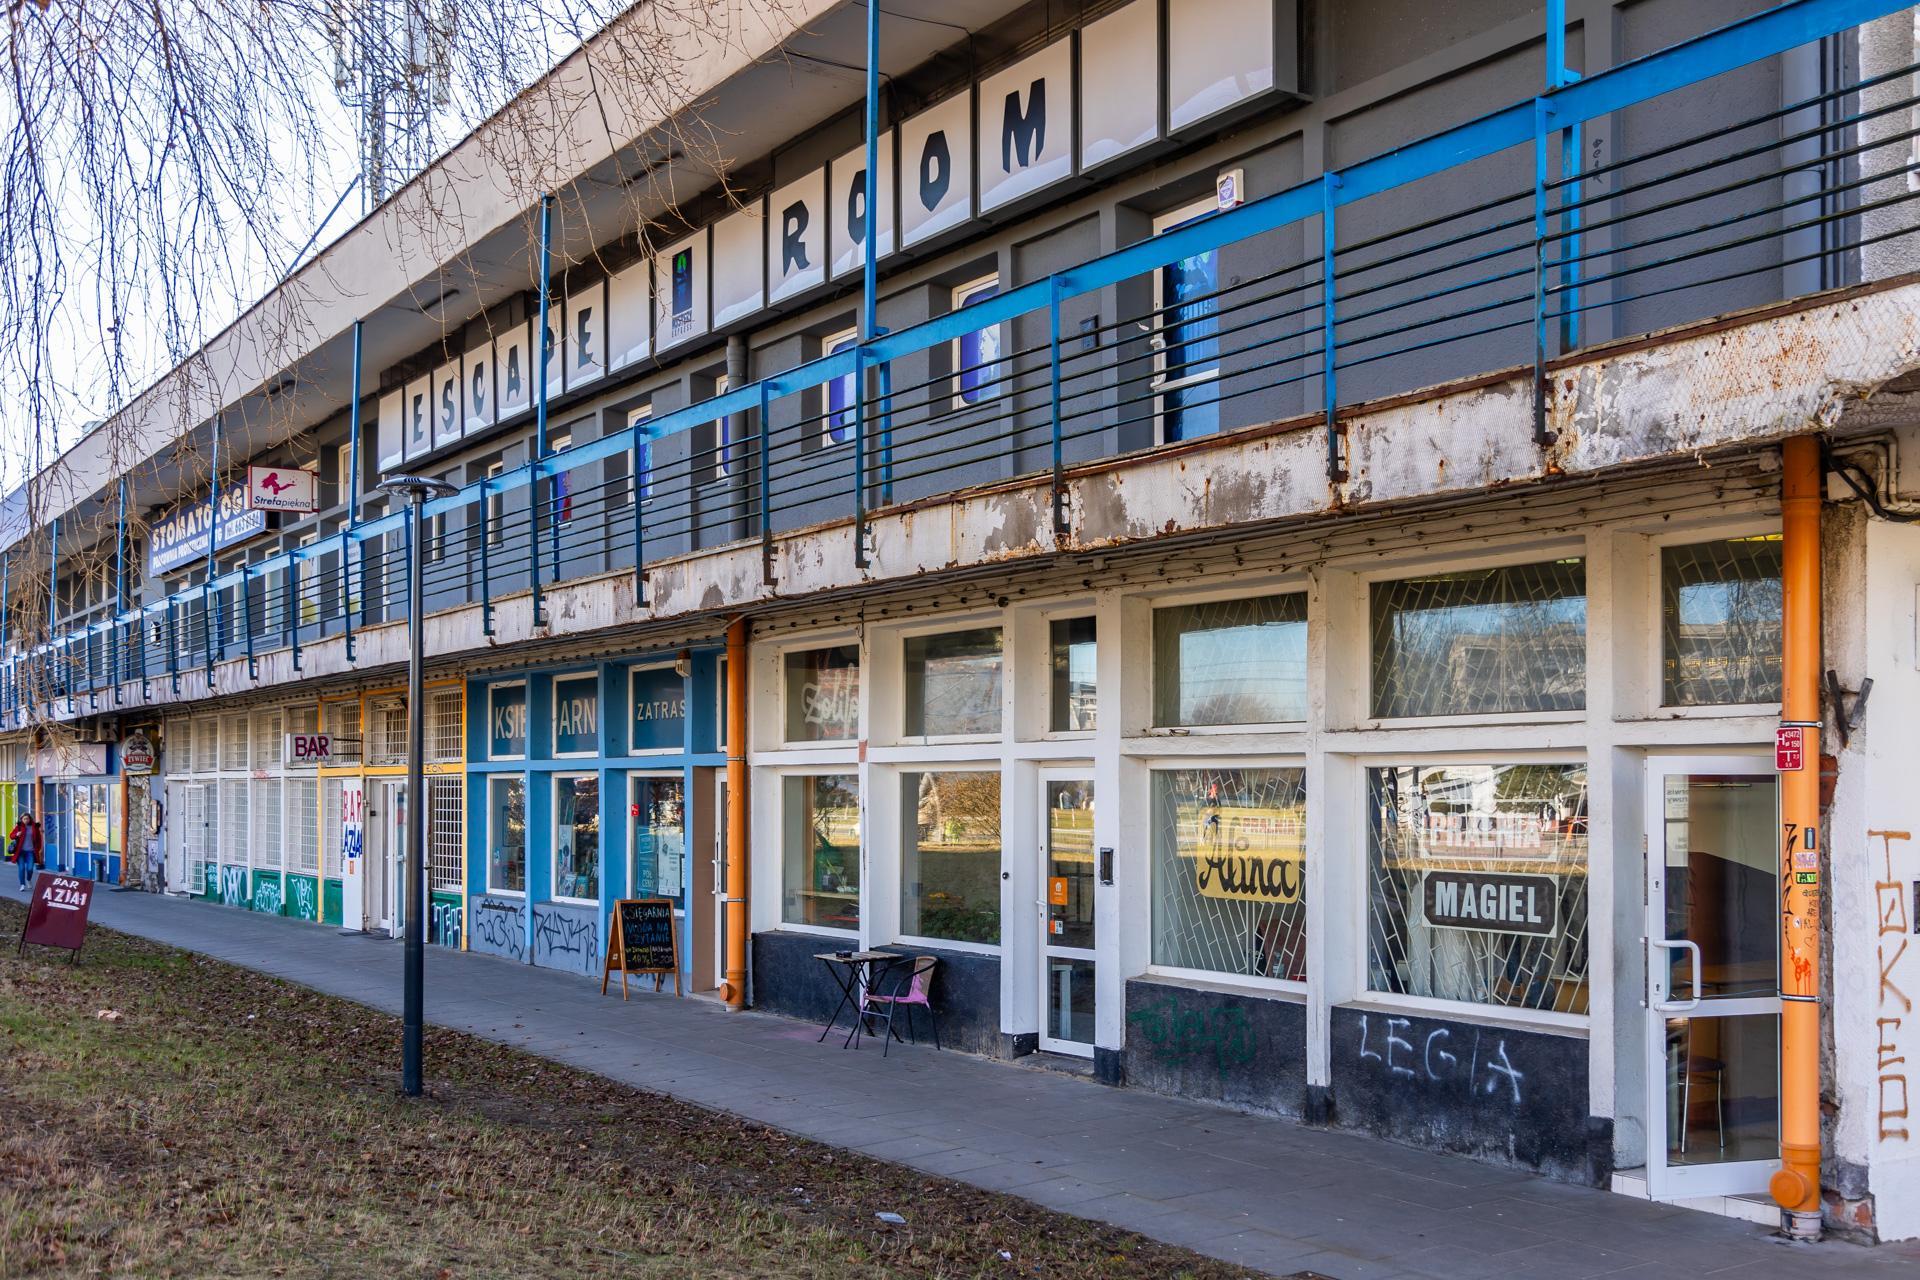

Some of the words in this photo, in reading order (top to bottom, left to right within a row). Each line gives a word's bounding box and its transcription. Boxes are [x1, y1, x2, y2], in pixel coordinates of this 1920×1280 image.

[413, 306, 593, 443] ESCAPE
[783, 77, 1047, 276] ROOM
[152, 484, 249, 551] STOMATOOGI
[559, 698, 596, 736] ARN
[637, 700, 686, 721] ZATRAS
[294, 735, 330, 757] BAR
[343, 789, 362, 822] BAR
[1429, 811, 1542, 848] PRALNIA
[1199, 817, 1297, 898] Alina
[53, 877, 80, 890] BAR
[1435, 880, 1542, 924] MAGIEL
[1358, 1014, 1523, 1103] LEGIA
